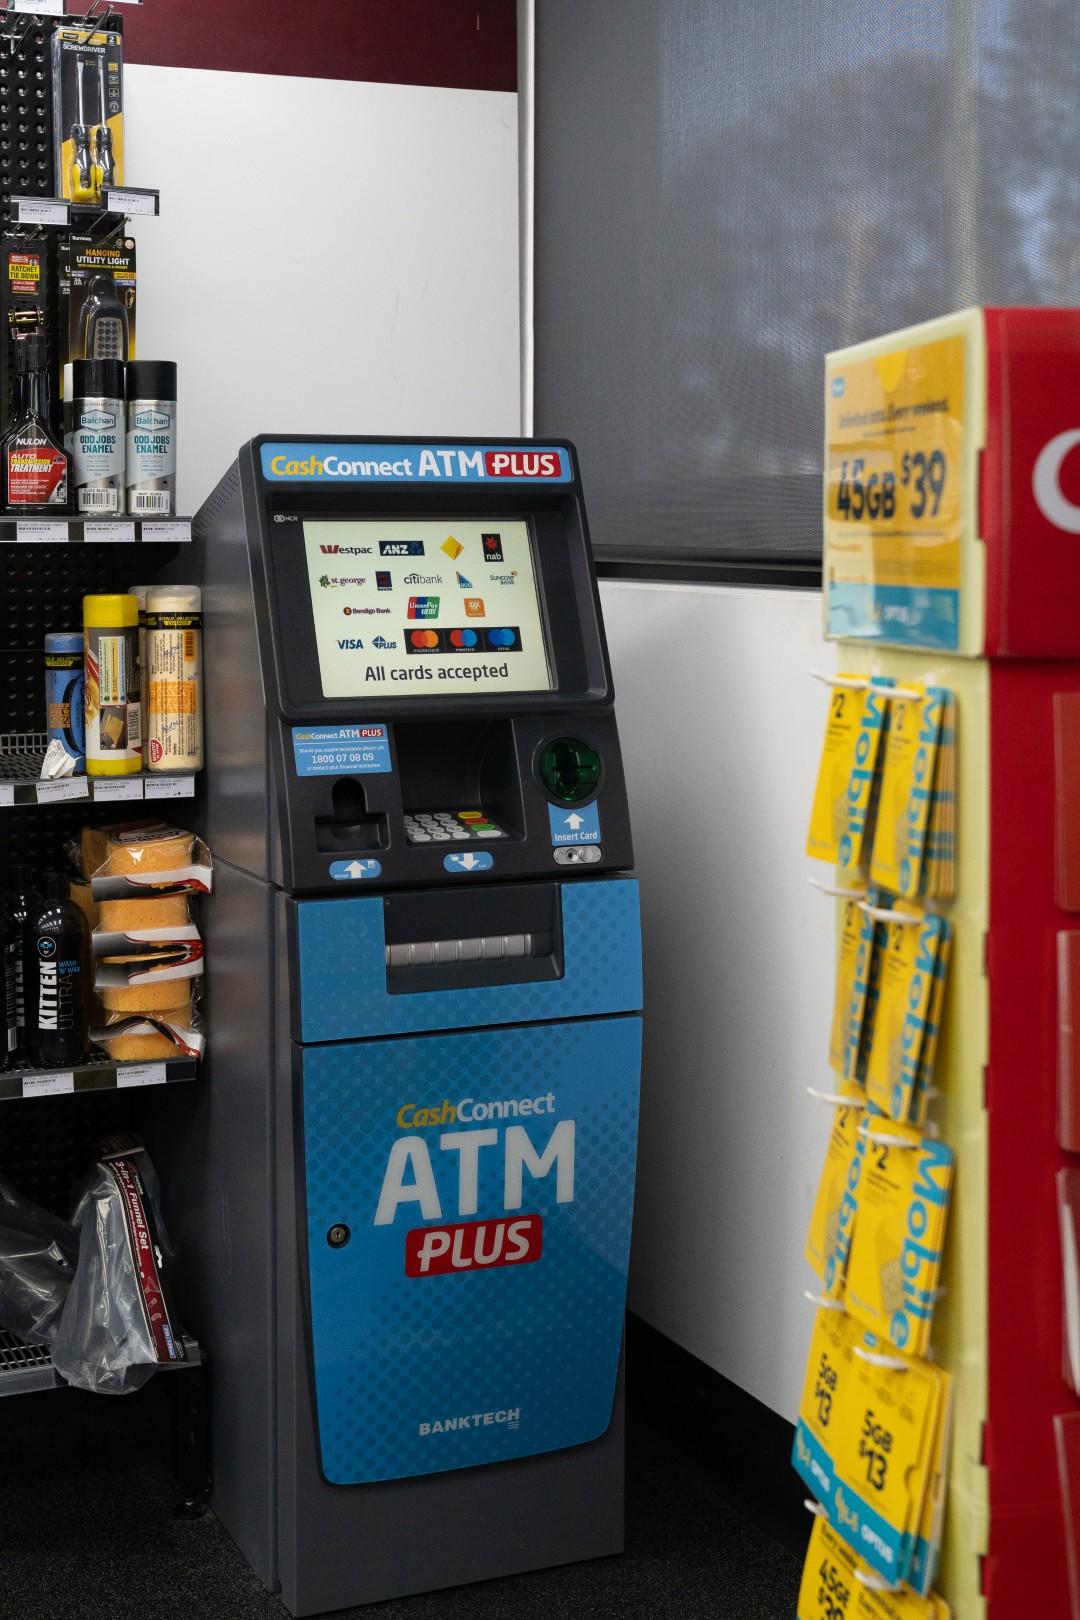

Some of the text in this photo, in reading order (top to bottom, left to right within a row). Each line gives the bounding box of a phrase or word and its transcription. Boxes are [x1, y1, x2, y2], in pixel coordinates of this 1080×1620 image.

[62, 43, 106, 54] SCREWDRIVER
[85, 249, 120, 258] HANGING
[76, 256, 130, 266] UTILITY LIGHT
[11, 265, 38, 273] RATCHET
[16, 438, 47, 446] NULON
[80, 435, 117, 444] ODD JOBS
[134, 435, 170, 444] ODD JOBS
[82, 445, 114, 454] ENAMEL
[136, 445, 168, 454] ENAMEL
[11, 464, 54, 473] TREATMENT
[271, 449, 555, 478] CashConnect ATM PLUS
[837, 448, 946, 522] 45GB $39
[320, 544, 373, 556] Westpac
[382, 544, 409, 555] ANZ
[486, 552, 502, 560] nab
[404, 572, 443, 585] citibank
[352, 607, 376, 615] Bendigo
[410, 601, 439, 609] UnionPay
[337, 639, 364, 650] VISA
[380, 641, 398, 650] PLUS
[365, 663, 509, 682] All cards accepted
[339, 729, 360, 739] ATM
[362, 729, 382, 738] PLUS
[311, 752, 374, 764] 1800 07 08 09
[554, 831, 598, 843] Insert Card
[39, 961, 57, 1030] KITTEN
[58, 973, 74, 1030] ULTRA
[395, 1091, 556, 1129] CashConnect
[373, 1118, 576, 1226] ATM
[115, 1160, 135, 1190] 3-in-1
[130, 1191, 146, 1231] Funnel
[139, 1233, 150, 1250] Set
[416, 1219, 532, 1273] PLUS
[889, 1138, 954, 1349] Mobile
[818, 1352, 838, 1393] 5GB
[815, 1379, 833, 1427] $13
[418, 1407, 521, 1436] BANKTECH
[861, 1407, 893, 1453] 5GB
[858, 1438, 888, 1492] $13
[861, 1523, 893, 1563] OPTUS
